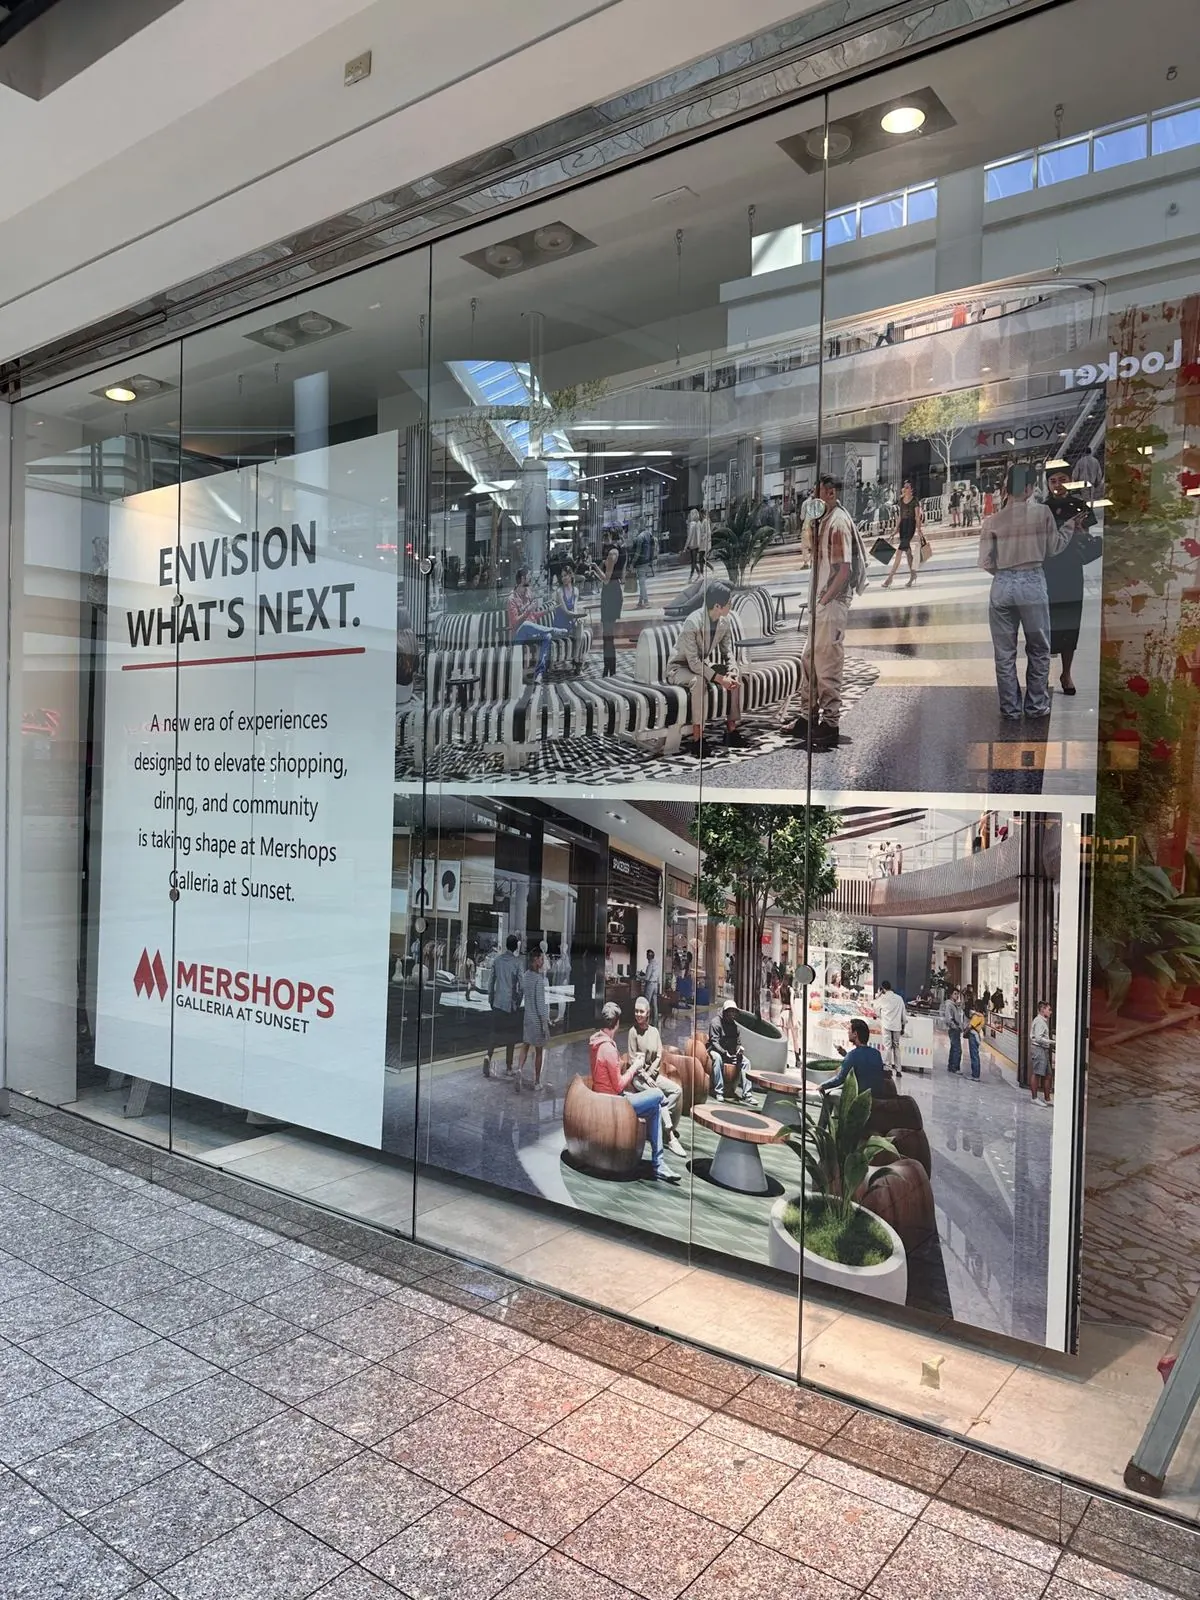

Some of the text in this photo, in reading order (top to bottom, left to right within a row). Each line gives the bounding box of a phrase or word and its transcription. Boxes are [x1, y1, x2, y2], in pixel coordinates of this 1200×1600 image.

[993, 417, 1065, 446] macy's
[159, 520, 317, 587] ENVISION
[127, 583, 360, 648] WHAT'S NEXT.
[150, 709, 328, 735] A new era of experiences
[134, 751, 348, 779] designed to elevate shopping,
[154, 790, 319, 822] dinng, and community
[138, 827, 337, 866] is taking shape at Mershops
[169, 870, 295, 902] Galleria at Sunset.
[177, 960, 335, 1019] MERSHOPS
[176, 994, 310, 1034] GALLERIA AT SUNSET
